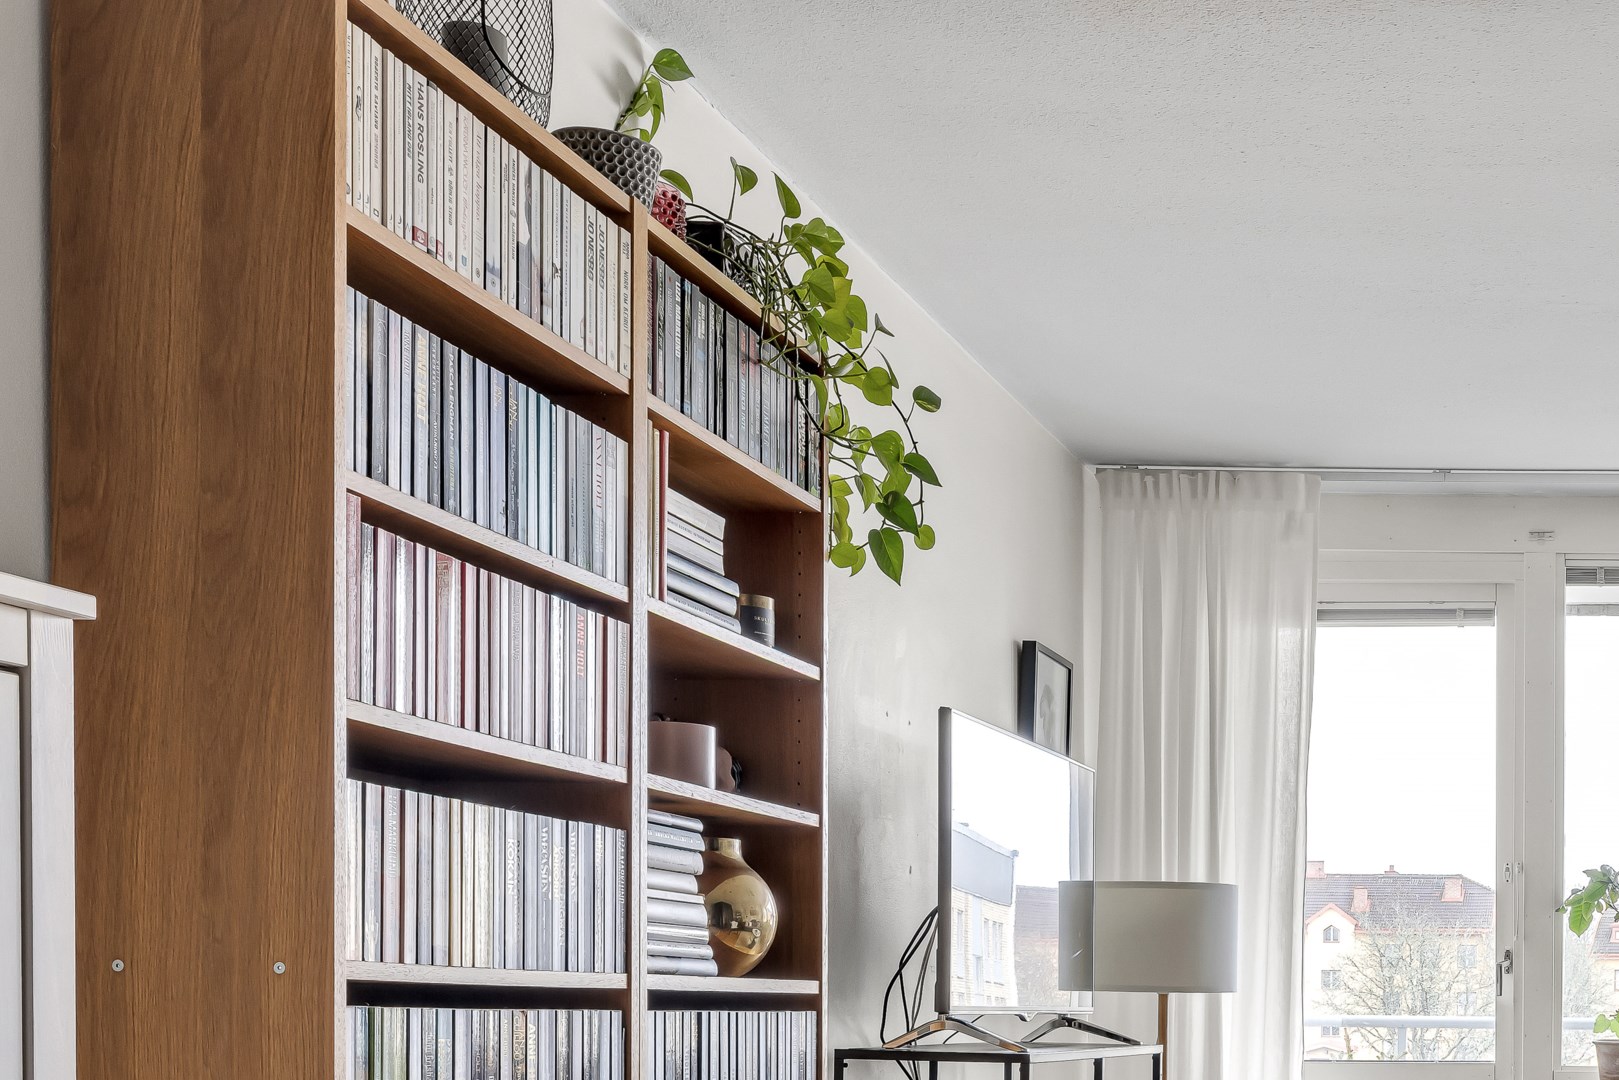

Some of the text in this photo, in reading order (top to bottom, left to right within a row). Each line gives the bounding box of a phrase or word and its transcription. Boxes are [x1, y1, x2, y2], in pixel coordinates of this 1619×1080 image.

[416, 82, 424, 186] HANS ROSLING
[587, 215, 595, 234] JO
[599, 224, 605, 243] JO
[623, 292, 629, 305] OM
[416, 333, 427, 381] ANNE
[416, 382, 427, 426] HOLT
[576, 613, 585, 680] ANNE HOLT
[507, 838, 515, 896] KOKAIN
[528, 1023, 536, 1064] ANNE
